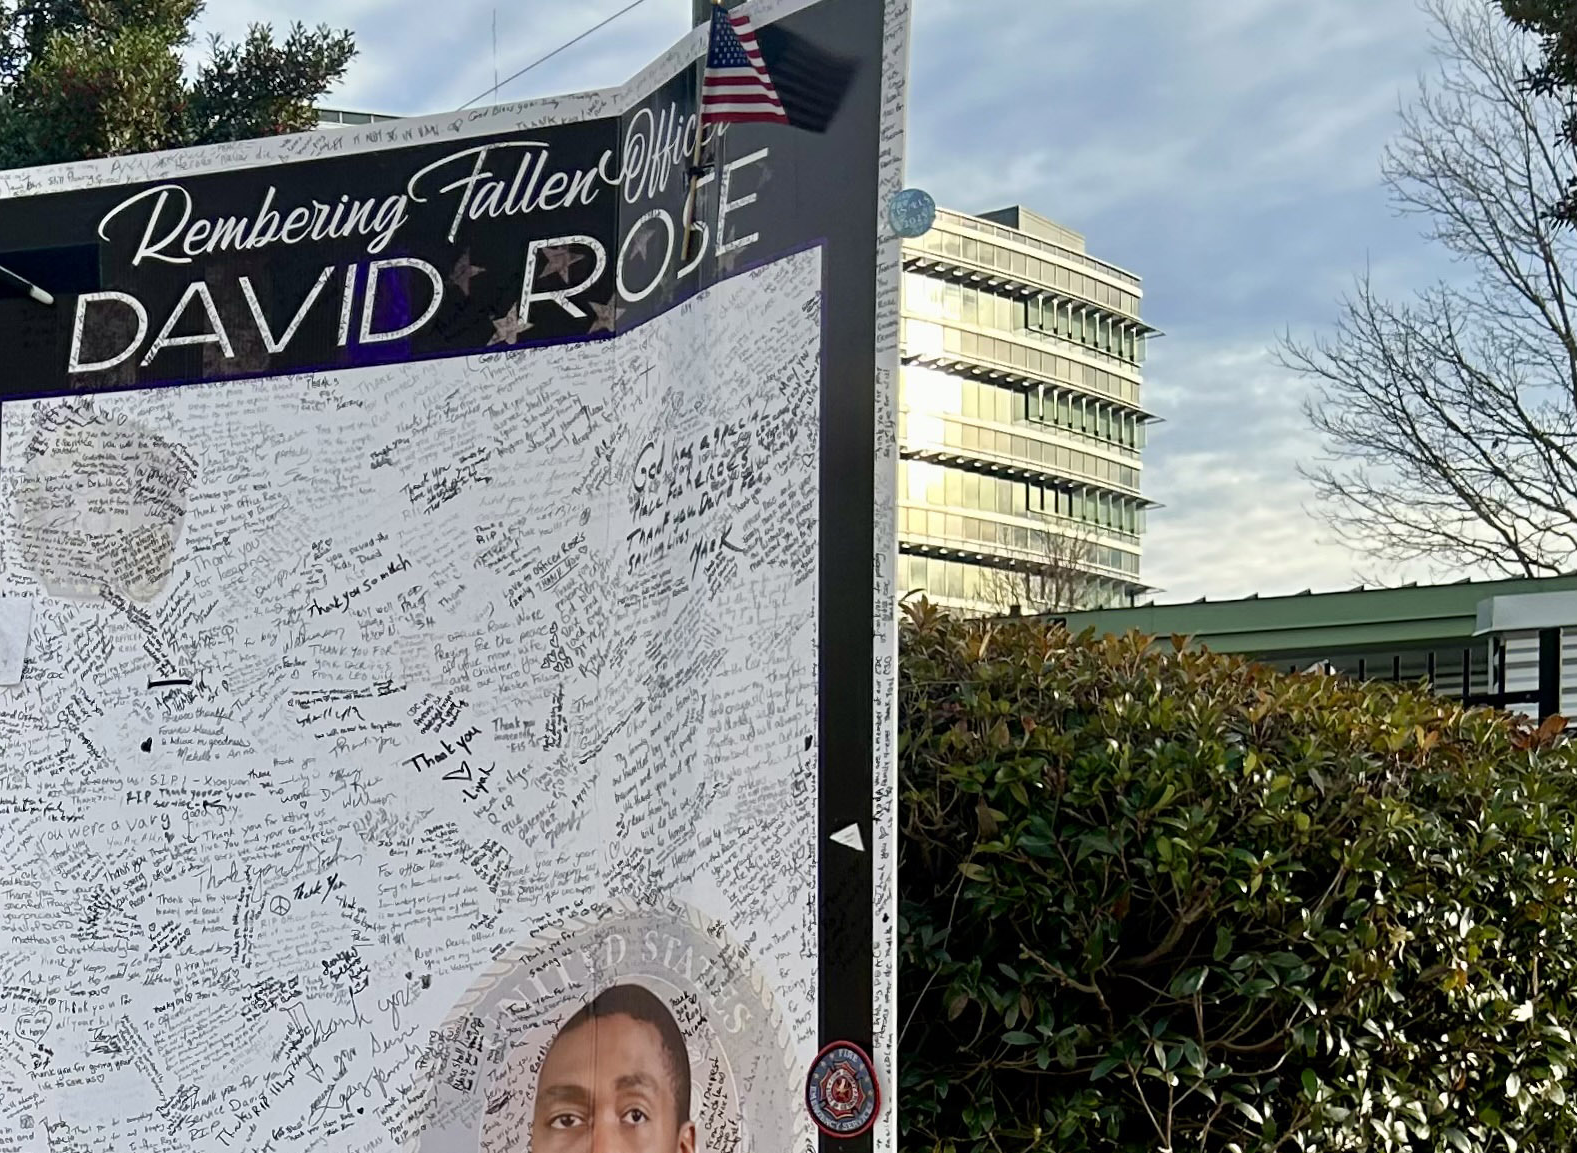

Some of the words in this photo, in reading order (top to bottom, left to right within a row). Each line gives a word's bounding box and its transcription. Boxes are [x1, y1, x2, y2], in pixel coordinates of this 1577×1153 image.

[98, 184, 408, 267] Rembering
[408, 140, 599, 244] Fallen
[68, 256, 444, 373] DAVID
[191, 549, 235, 572] Thank
[193, 576, 212, 588] for
[217, 555, 271, 580] keeping
[536, 565, 564, 591] THANK
[308, 597, 343, 618] Thank
[342, 586, 361, 613] you
[309, 645, 347, 656] THANK
[351, 646, 368, 656] YOU
[401, 739, 455, 772] Thank
[456, 726, 483, 755] you
[36, 779, 56, 794] you
[126, 790, 152, 805] RIP
[67, 823, 105, 838] were
[110, 820, 121, 830] a
[203, 829, 235, 840] Thank
[241, 823, 262, 836] you
[265, 814, 278, 826] for
[102, 860, 131, 883] Thank
[131, 856, 146, 873] you
[192, 860, 246, 894] Thank
[293, 879, 322, 900] Thank
[519, 947, 546, 965] Thank
[838, 1048, 859, 1063] FIRE
[26, 1069, 56, 1081] Thank
[57, 1068, 72, 1080] you
[184, 1103, 226, 1129] Service
[190, 1119, 221, 1142] RIP
